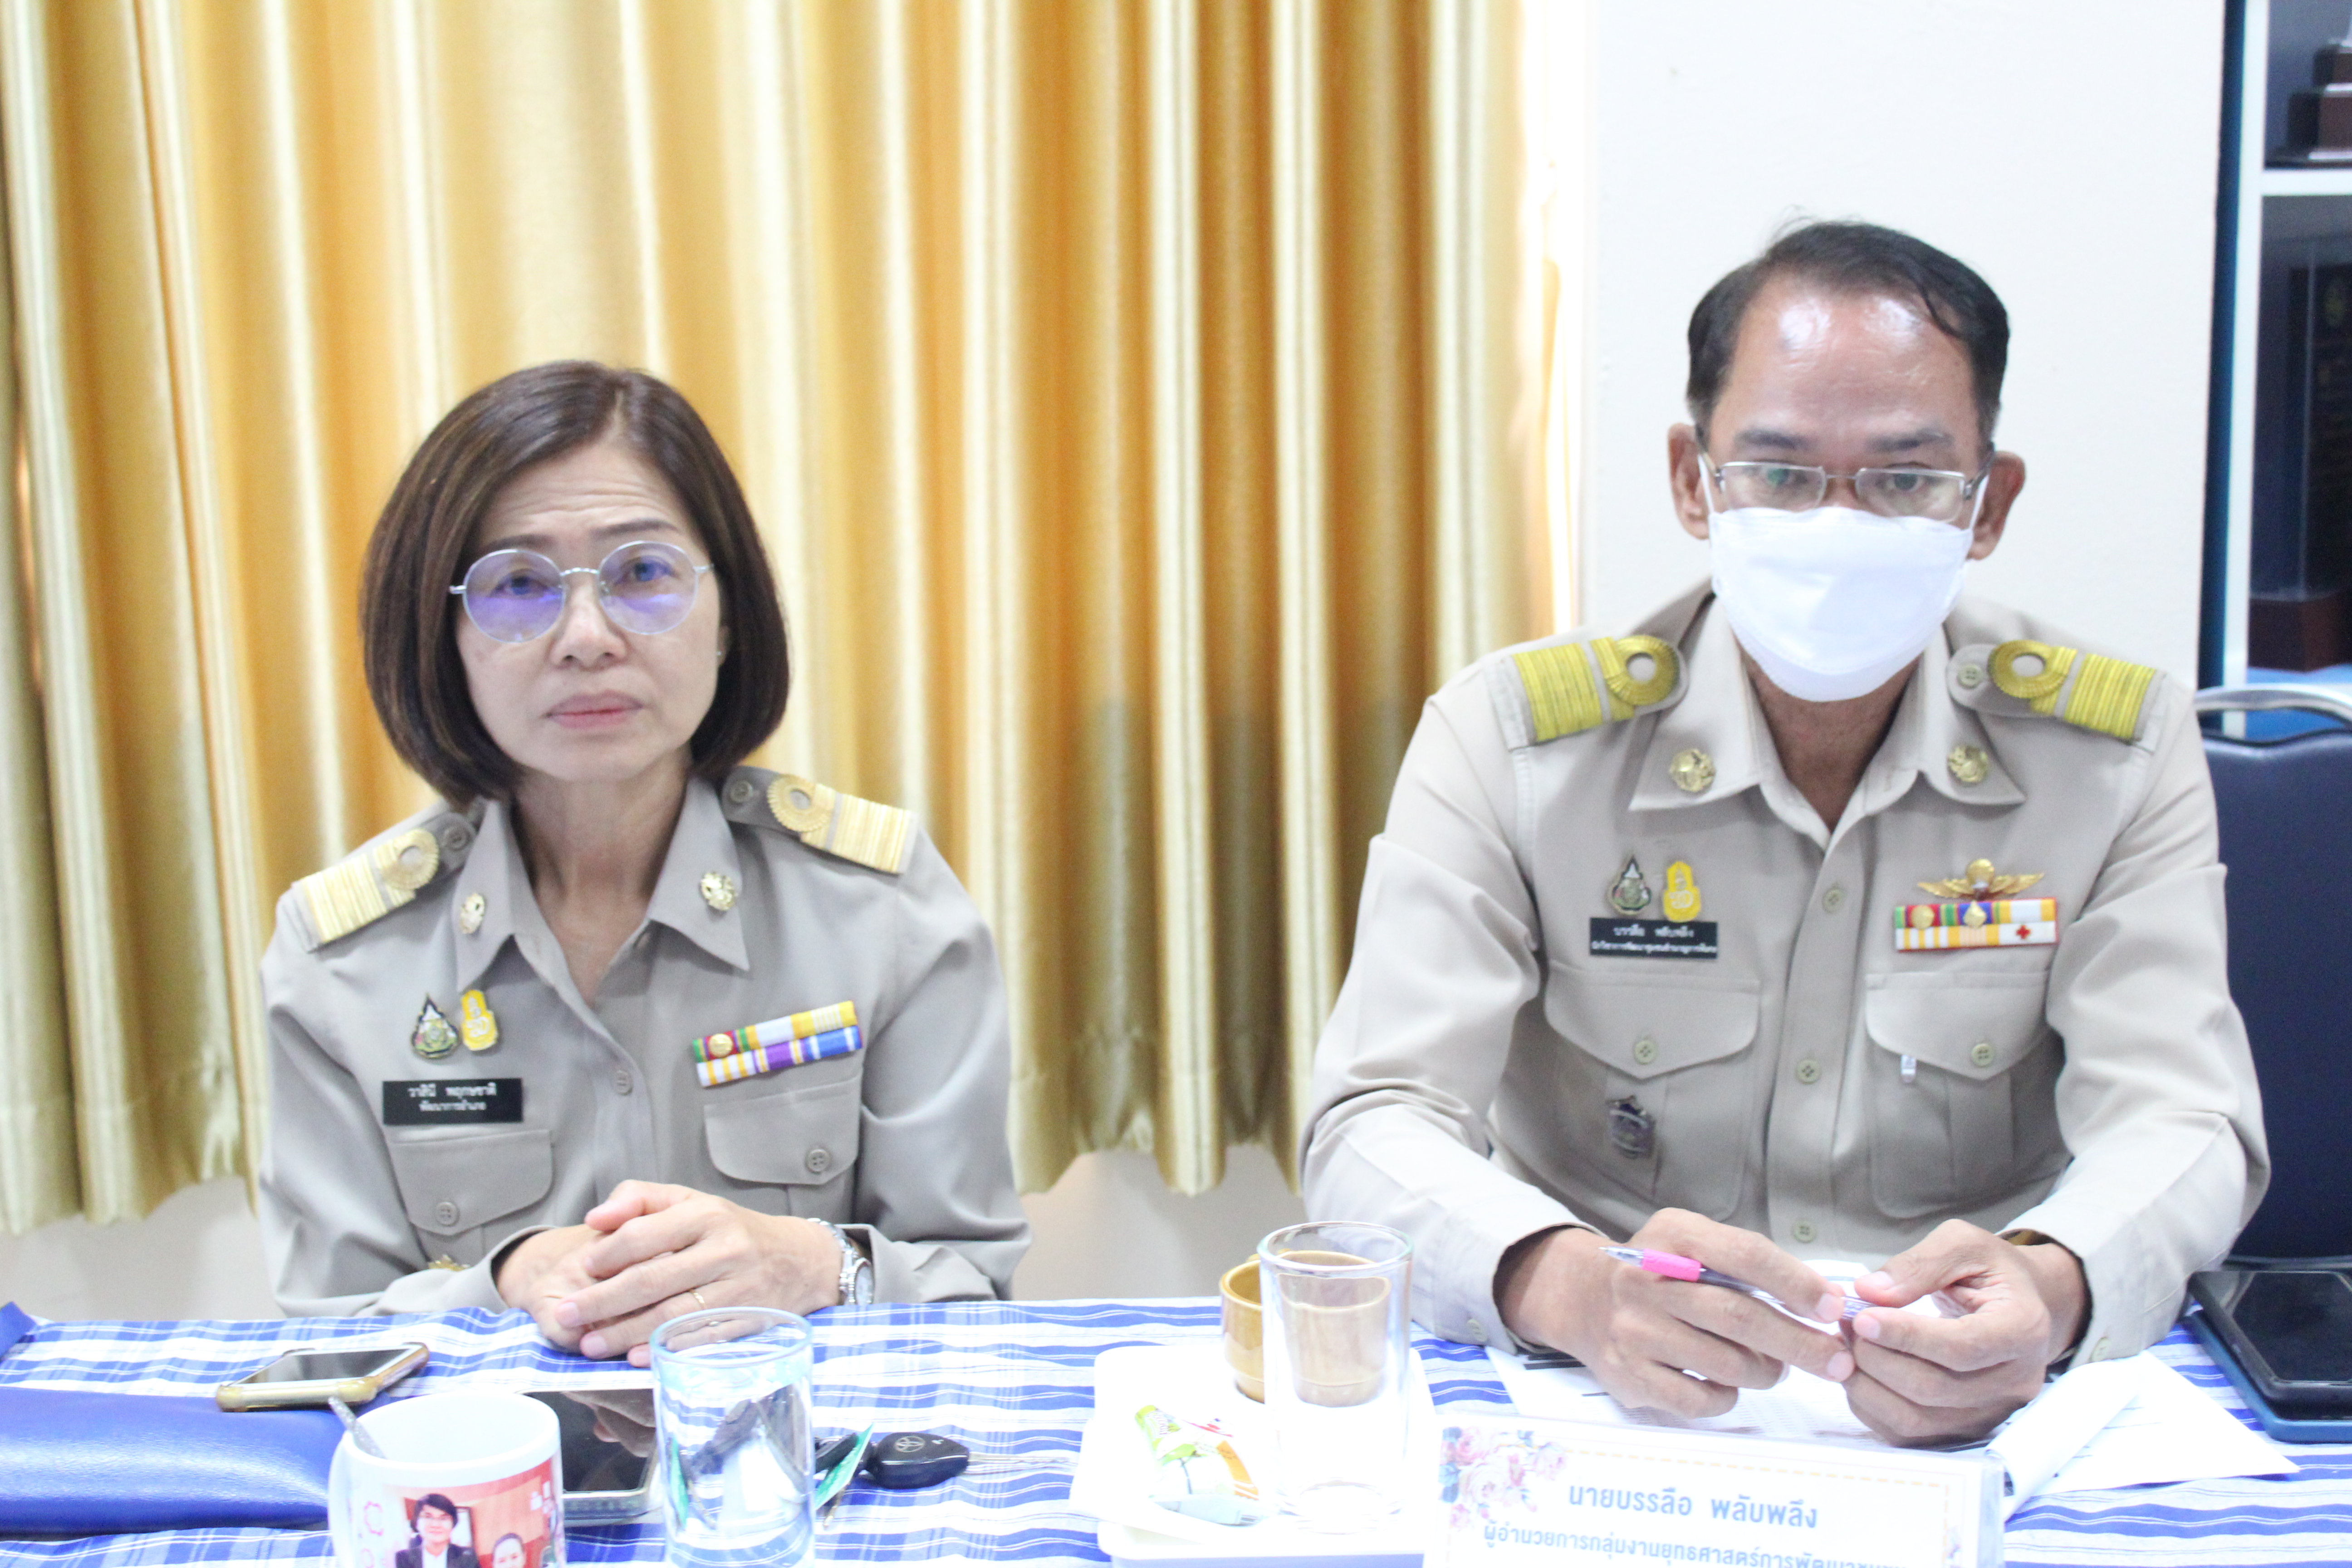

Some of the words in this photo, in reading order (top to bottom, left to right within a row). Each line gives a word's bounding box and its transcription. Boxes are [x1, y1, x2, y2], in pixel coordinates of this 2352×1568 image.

[1568, 1485, 1693, 1516] นายบรรลือ
[1710, 1493, 1818, 1529] พลับพลึง
